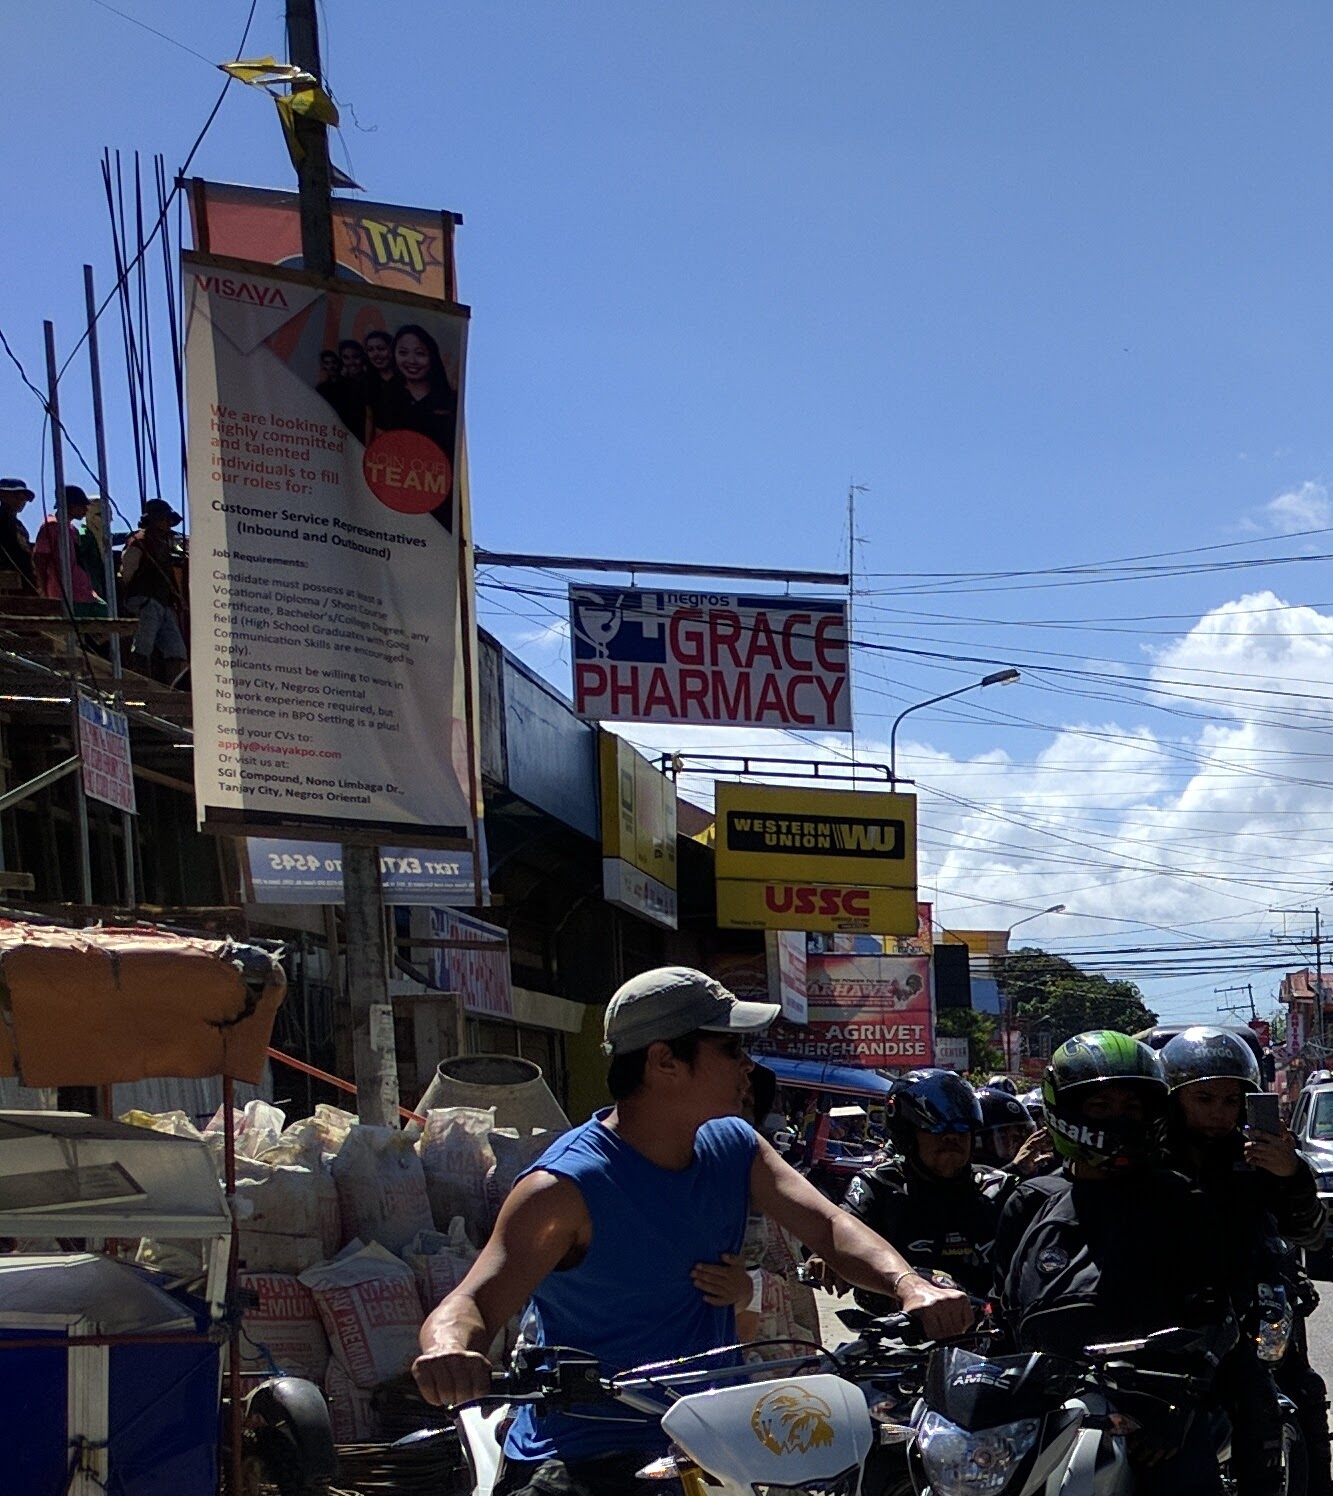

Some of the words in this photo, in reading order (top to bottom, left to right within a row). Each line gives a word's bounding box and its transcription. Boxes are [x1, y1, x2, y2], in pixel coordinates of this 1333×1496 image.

[194, 273, 289, 308] VISAYA
[210, 403, 238, 420] We
[242, 410, 267, 426] are
[270, 411, 328, 437] looking
[332, 424, 350, 441] for
[210, 418, 259, 441] highly
[262, 428, 346, 454] committed
[210, 435, 241, 451] and
[244, 439, 311, 462] talented
[211, 453, 296, 479] individuals
[300, 467, 317, 481] to
[320, 469, 341, 485] fill
[367, 462, 447, 495] TEAM
[211, 471, 239, 484] our
[243, 474, 281, 491] roles
[285, 479, 313, 495] for:
[211, 500, 278, 520] Customer
[281, 507, 329, 526] Service
[333, 516, 427, 548] Representatives
[237, 520, 299, 541] (Inbound
[302, 529, 328, 544] and
[331, 534, 391, 561] Outbound)
[212, 548, 231, 560] Job
[233, 551, 309, 568] Requirements:
[212, 570, 270, 587] Candidate
[272, 578, 300, 589] must
[302, 582, 345, 597] possess
[212, 584, 272, 600] Vocational
[274, 591, 320, 607] Diploma
[213, 599, 274, 617] Certificate,
[213, 613, 238, 626] field
[240, 616, 270, 631] (High
[272, 618, 310, 634] School
[312, 623, 365, 642] Graduates
[213, 628, 302, 646] Communication
[304, 637, 331, 651] Skills
[334, 642, 352, 652] are
[669, 606, 848, 674] GRACE
[214, 657, 272, 673] Applicants
[274, 664, 303, 676] must
[305, 666, 320, 677] be
[321, 667, 357, 682] willing
[358, 672, 371, 682] to
[372, 675, 393, 688] work
[215, 674, 252, 688] Tanjay
[253, 677, 278, 692] City,
[281, 681, 320, 696] Negros
[322, 685, 366, 699] Oriental
[575, 662, 846, 726] PHARMACY
[215, 688, 232, 699] No
[234, 691, 262, 702] work
[264, 694, 325, 711] experience
[327, 700, 376, 716] required,
[378, 705, 394, 718] but
[216, 703, 276, 719] Experience
[278, 707, 289, 719] in
[292, 710, 315, 722] BPO
[317, 713, 356, 728] Setting
[357, 716, 366, 727] is
[217, 724, 245, 736] Send
[247, 729, 272, 740] your
[274, 730, 295, 741] CVs
[298, 733, 313, 743] to:
[217, 739, 342, 760] apply@visayakpo.com
[218, 753, 233, 764] Or
[235, 756, 257, 767] visit
[259, 758, 272, 768] us
[274, 758, 290, 769] at:
[218, 767, 236, 779] SGI
[239, 769, 303, 785] Compound,
[305, 775, 336, 788] Nono
[338, 779, 383, 794] Limbaga
[218, 781, 256, 795] Tanjay
[257, 785, 283, 799] City,
[285, 788, 324, 802] Negros
[326, 791, 372, 804] Oriental
[733, 817, 831, 836] WESTERN
[841, 824, 896, 852] WU
[764, 832, 831, 849] UNION
[765, 885, 870, 916] USSC
[827, 1025, 925, 1041] AGRIVET
[788, 1042, 927, 1057] MERCHANDISE
